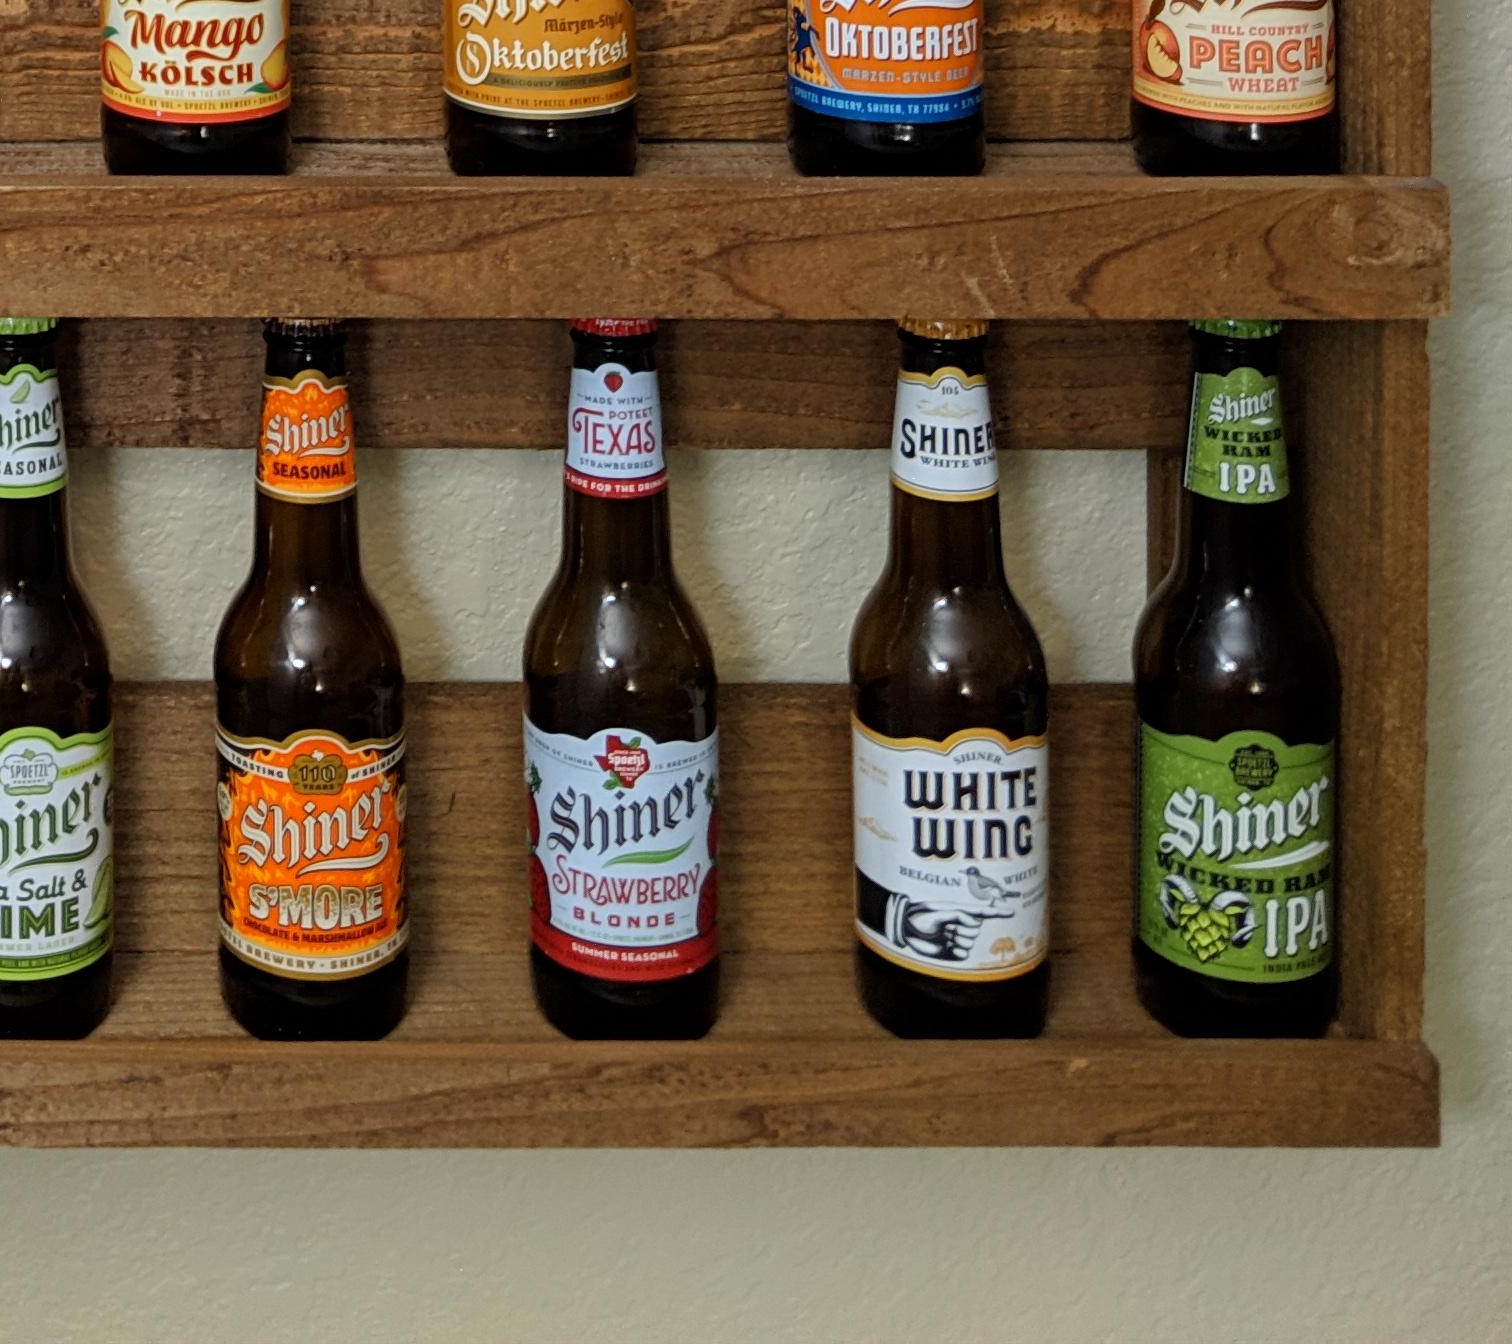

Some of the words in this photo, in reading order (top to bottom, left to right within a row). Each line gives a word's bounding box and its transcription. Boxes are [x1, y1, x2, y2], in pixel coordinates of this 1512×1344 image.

[124, 10, 264, 62] Mango
[825, 16, 978, 61] OKTOBERFEST
[1211, 24, 1244, 35] HILL
[1249, 24, 1309, 35] COUNTRY
[456, 31, 628, 85] Oktoberfest
[1189, 34, 1323, 74] PEACH
[138, 61, 253, 86] KÖLSCH
[1228, 77, 1300, 93] WHEAT
[584, 396, 612, 404] MADE
[617, 396, 643, 404] WITH
[609, 407, 653, 420] POTEET
[573, 407, 655, 456] TEXAS
[580, 457, 653, 470] STRAWBERRIES
[920, 456, 969, 468] WHITE
[1223, 445, 1271, 456] RAM
[272, 460, 346, 480] SEASONAL
[1220, 462, 1276, 493] IPA
[10, 765, 48, 779] SPOETZL
[298, 765, 336, 782] 110
[904, 767, 1037, 810] WHITE
[238, 779, 391, 868] Shiner
[546, 768, 704, 856] Shiner
[1159, 775, 1329, 860] Shiner
[912, 814, 1033, 859] WING
[17, 875, 66, 902] Salt
[72, 868, 88, 892] &
[552, 854, 700, 906] STRAWBERRY
[899, 865, 961, 887] BELGIAN
[1003, 867, 1038, 886] WHITE
[249, 883, 383, 930] S'MORE
[573, 907, 675, 928] BLONDE
[1264, 889, 1327, 957] IPA
[571, 942, 618, 961] SUMMER
[621, 950, 679, 962] SEASONAL
